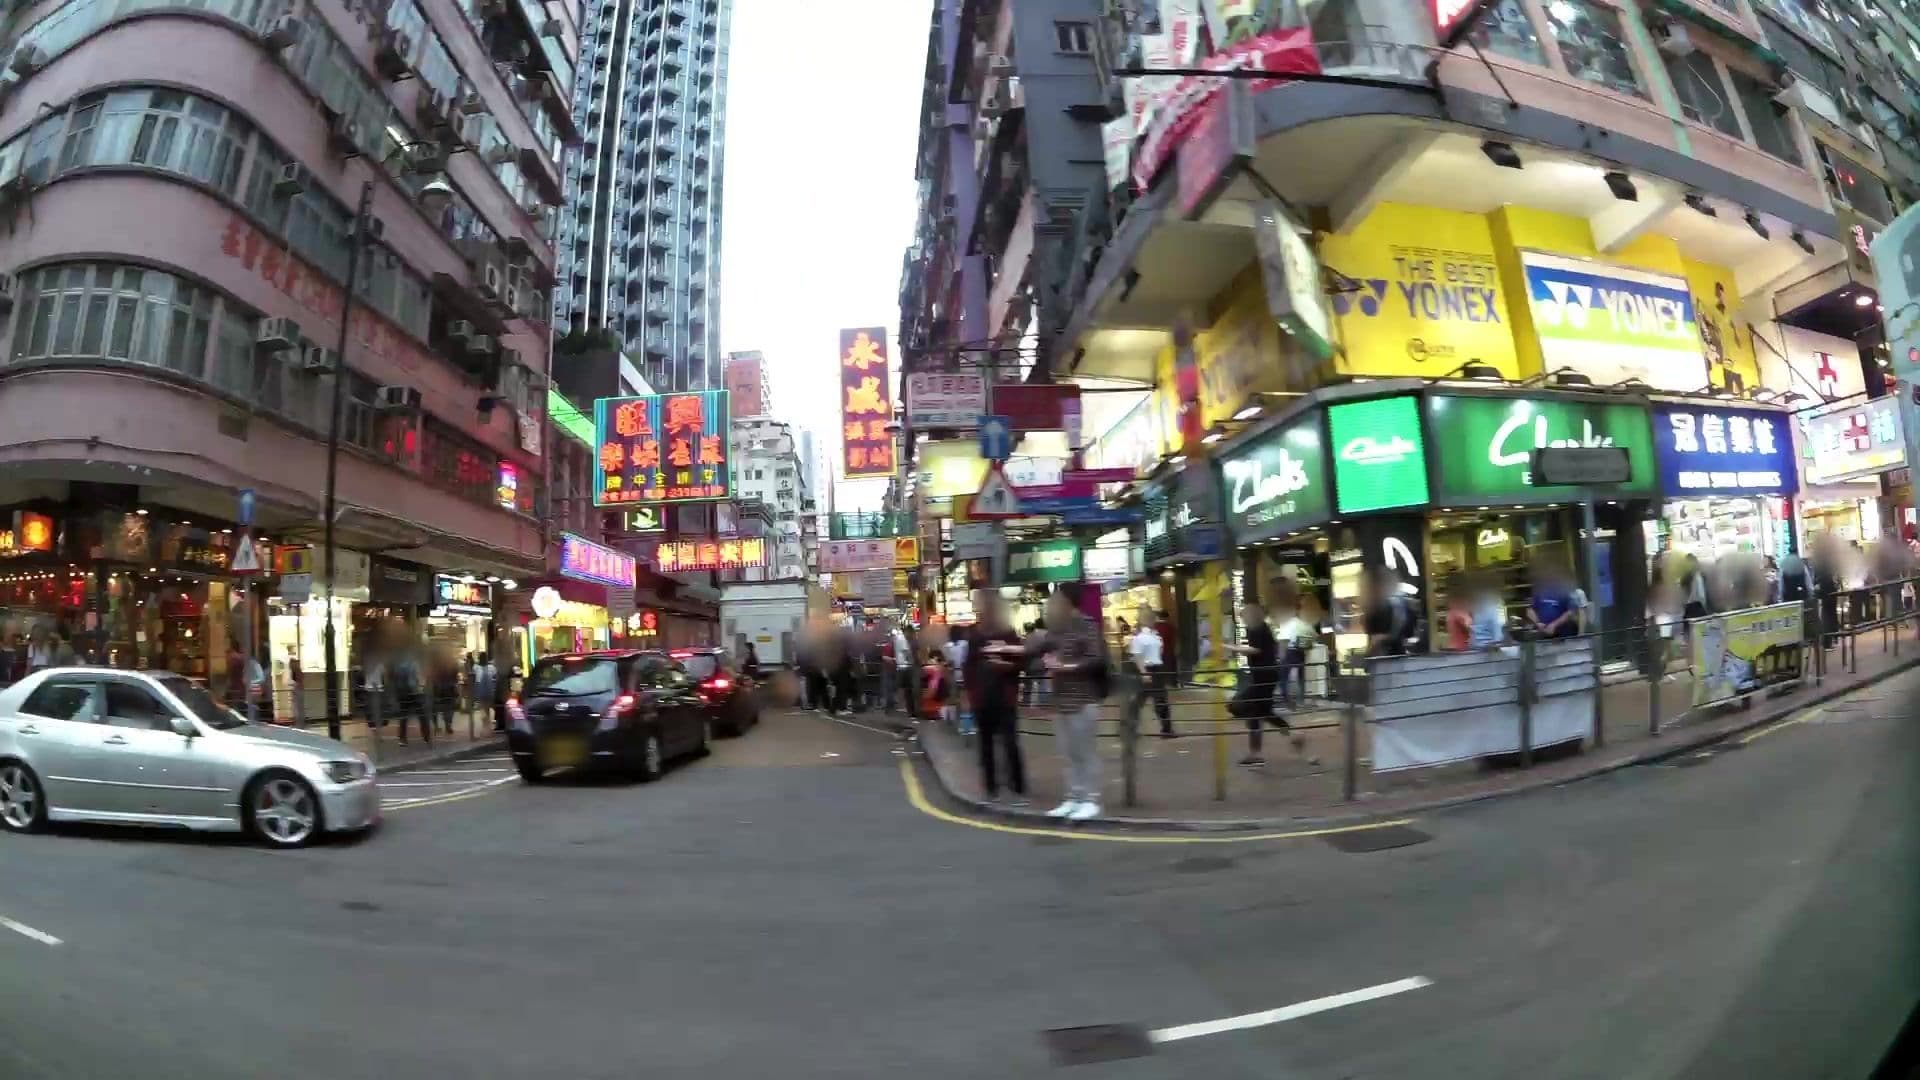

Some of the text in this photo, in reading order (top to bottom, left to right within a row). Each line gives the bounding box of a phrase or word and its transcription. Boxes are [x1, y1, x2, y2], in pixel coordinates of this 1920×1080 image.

[1393, 256, 1496, 285] THE BEST
[1397, 281, 1500, 324] YONEX
[1599, 287, 1691, 338] YONEX
[1489, 399, 1614, 467] Clarks
